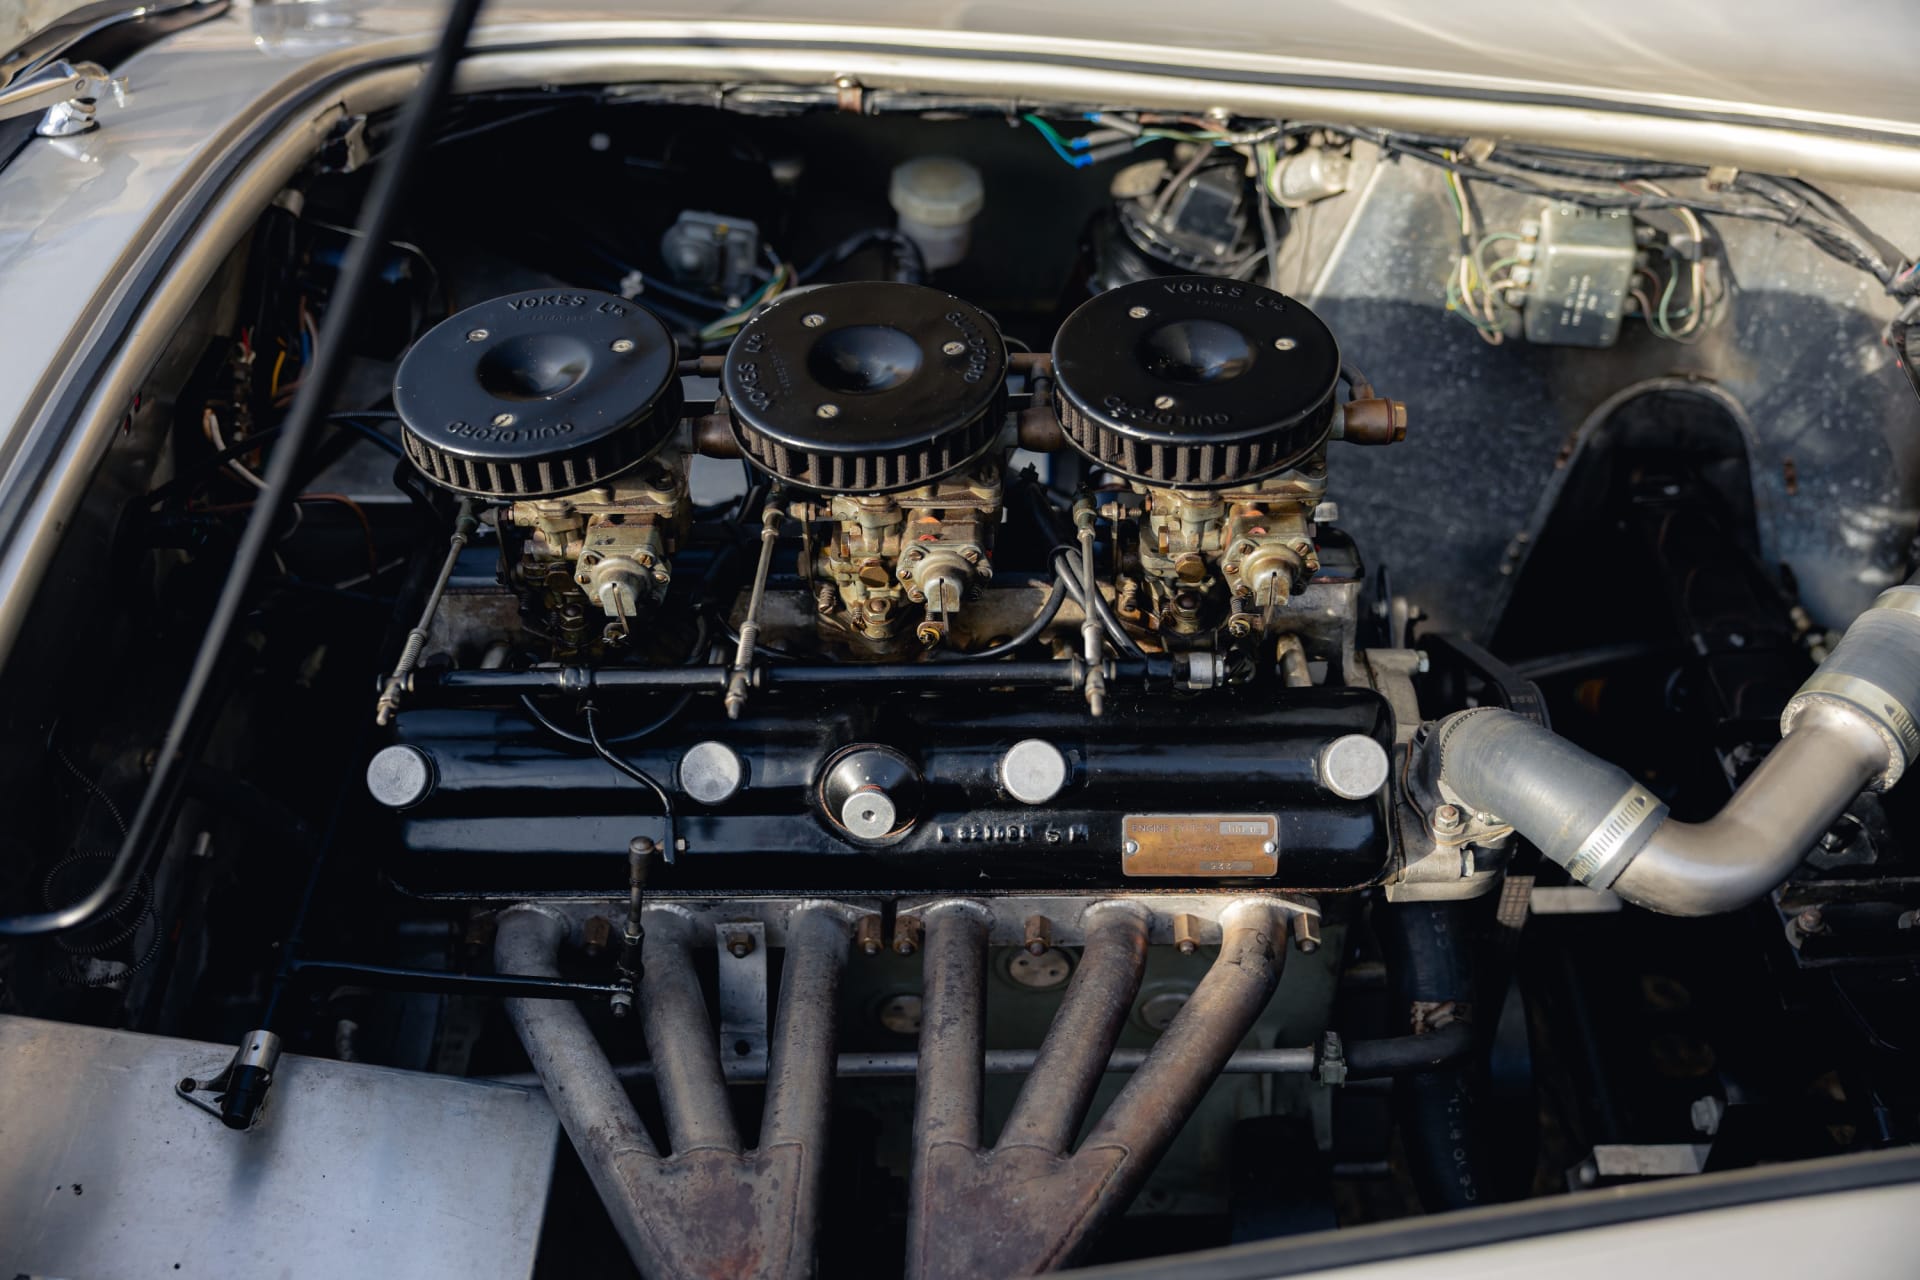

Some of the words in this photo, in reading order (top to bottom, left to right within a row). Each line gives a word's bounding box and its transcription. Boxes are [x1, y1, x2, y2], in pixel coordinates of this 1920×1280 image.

[1163, 283, 1243, 298] VOKES
[507, 295, 588, 311] VOKES
[738, 362, 769, 411] VOKES
[446, 421, 575, 442] GUILDFORD
